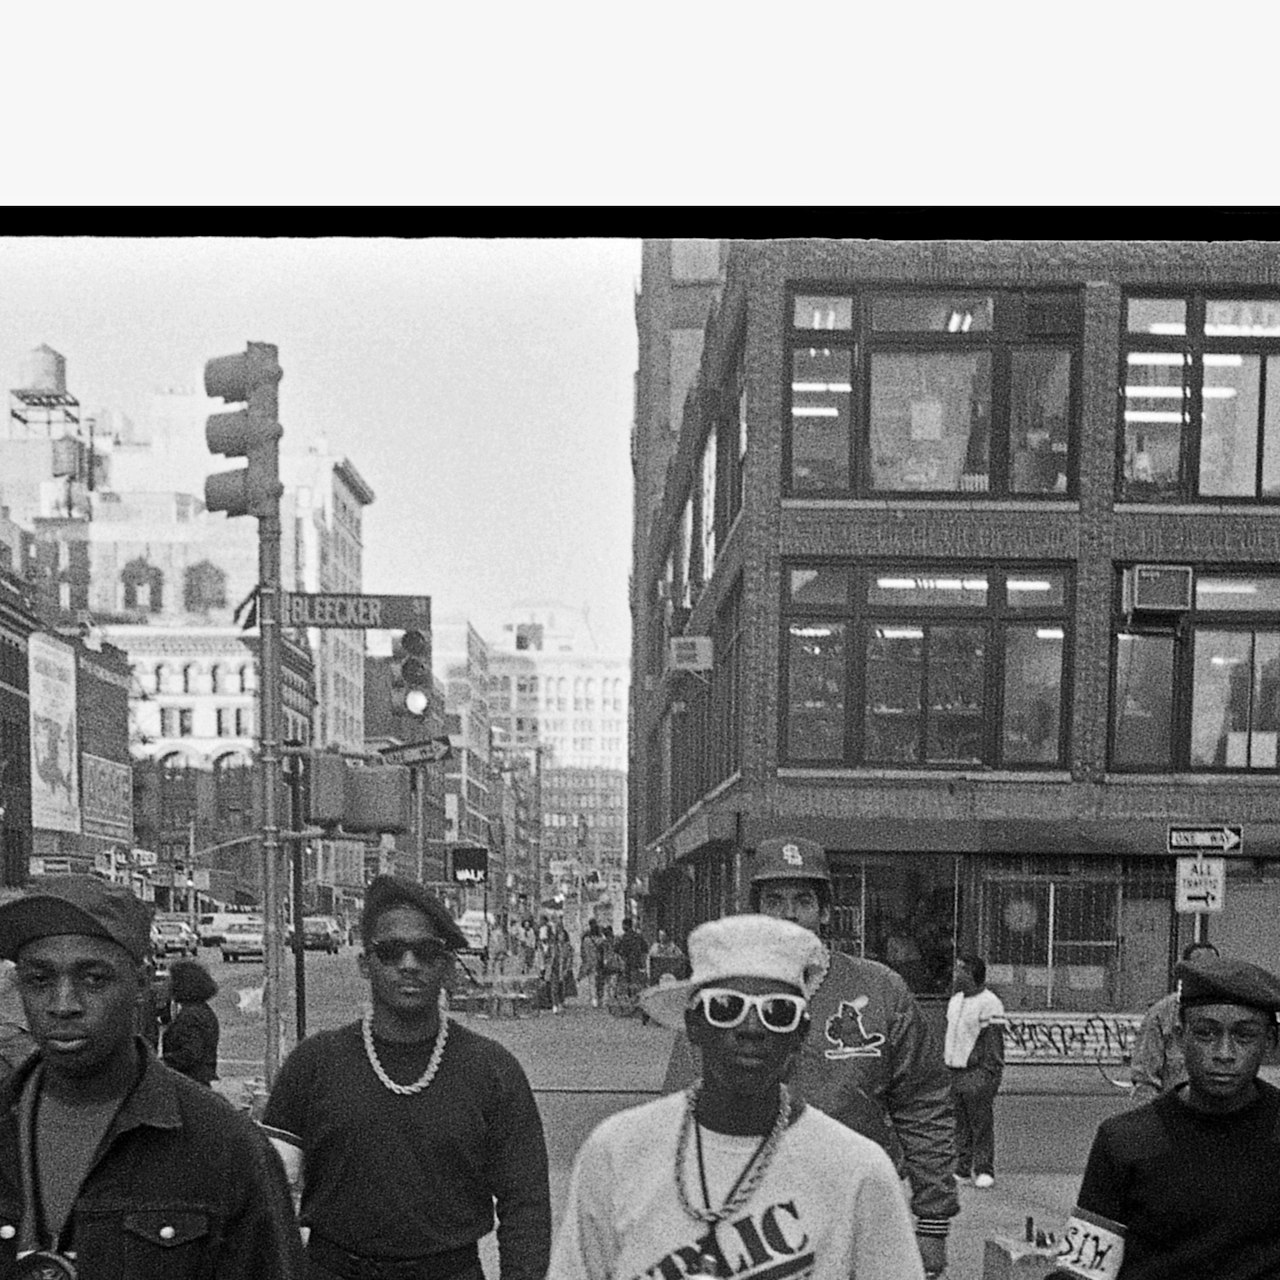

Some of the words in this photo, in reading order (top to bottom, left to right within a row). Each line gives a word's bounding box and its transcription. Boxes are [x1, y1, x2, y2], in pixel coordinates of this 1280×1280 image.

[291, 597, 382, 625] BLEECKER
[455, 868, 486, 882] WALK
[1190, 863, 1211, 875] ALL
